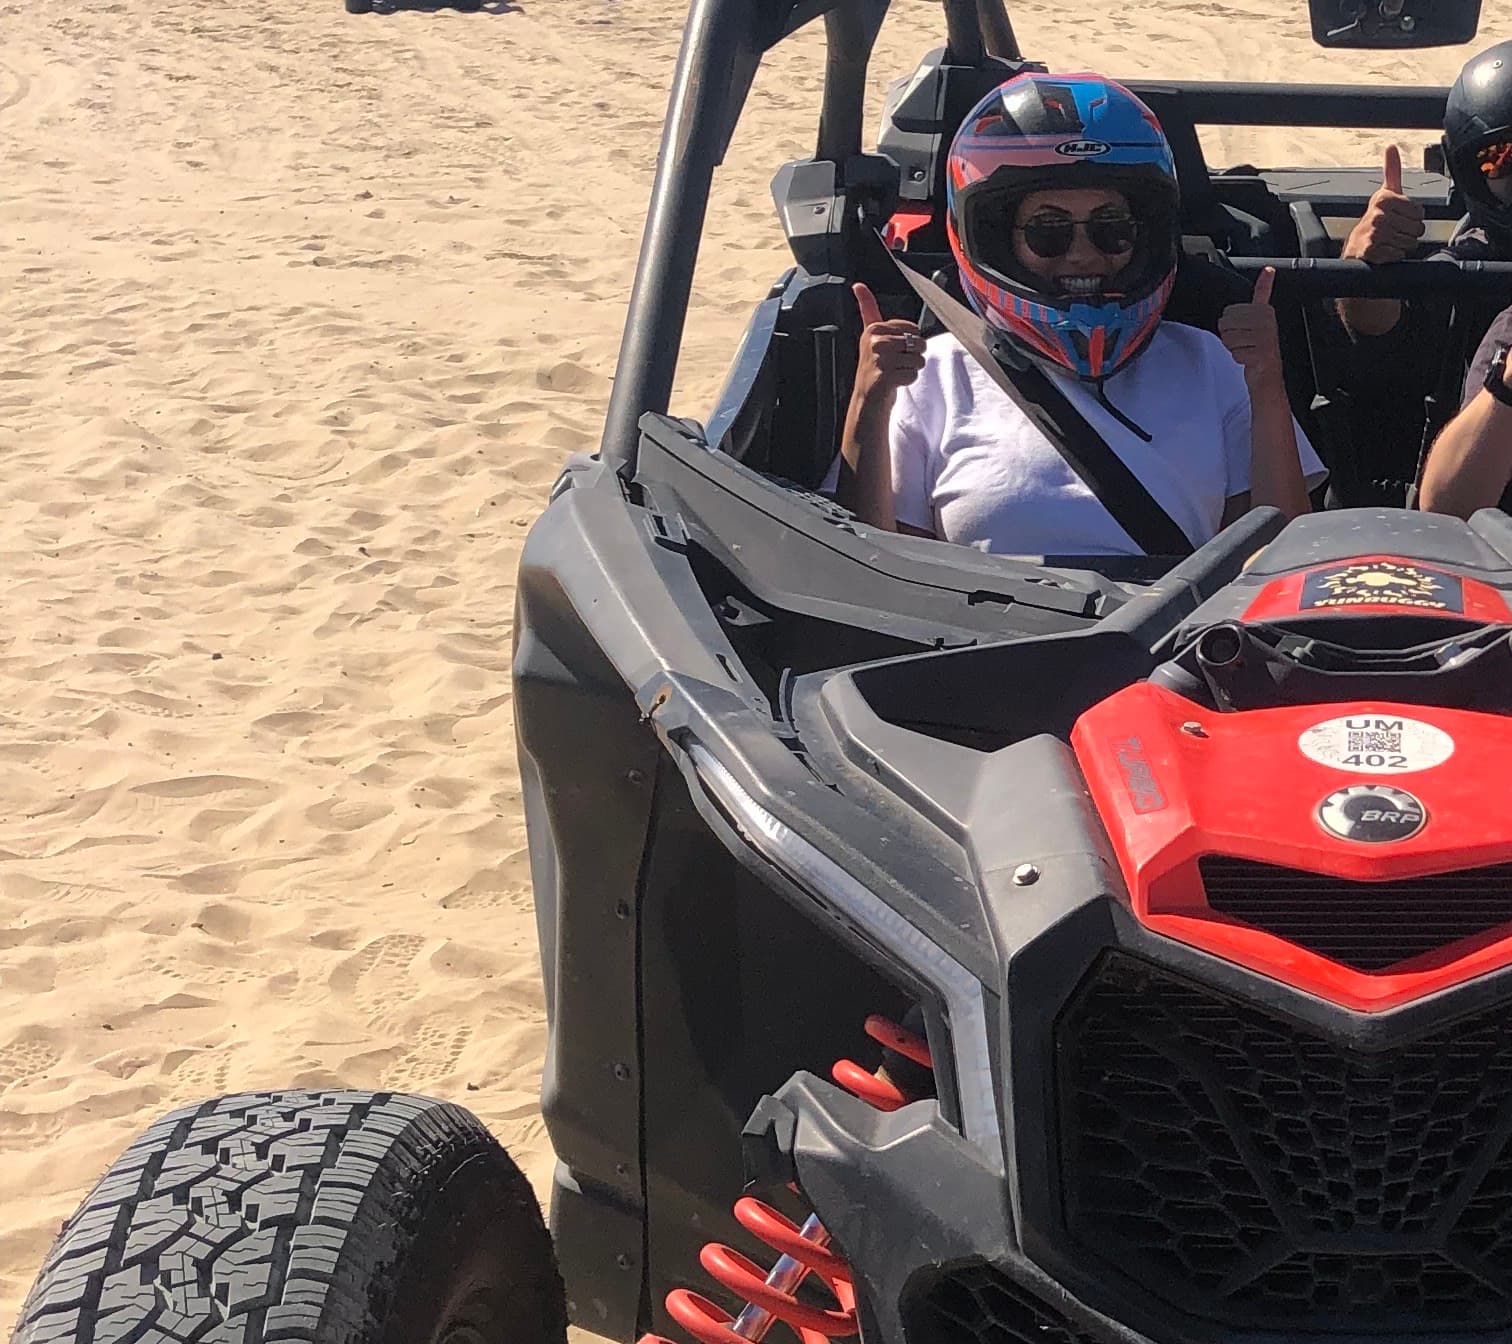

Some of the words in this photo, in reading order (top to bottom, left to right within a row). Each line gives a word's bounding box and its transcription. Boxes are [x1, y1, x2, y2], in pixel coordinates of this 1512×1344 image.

[1063, 143, 1103, 153] HJC
[1345, 719, 1404, 731] UM
[1341, 753, 1408, 769] 402
[1361, 810, 1421, 824] BRP
